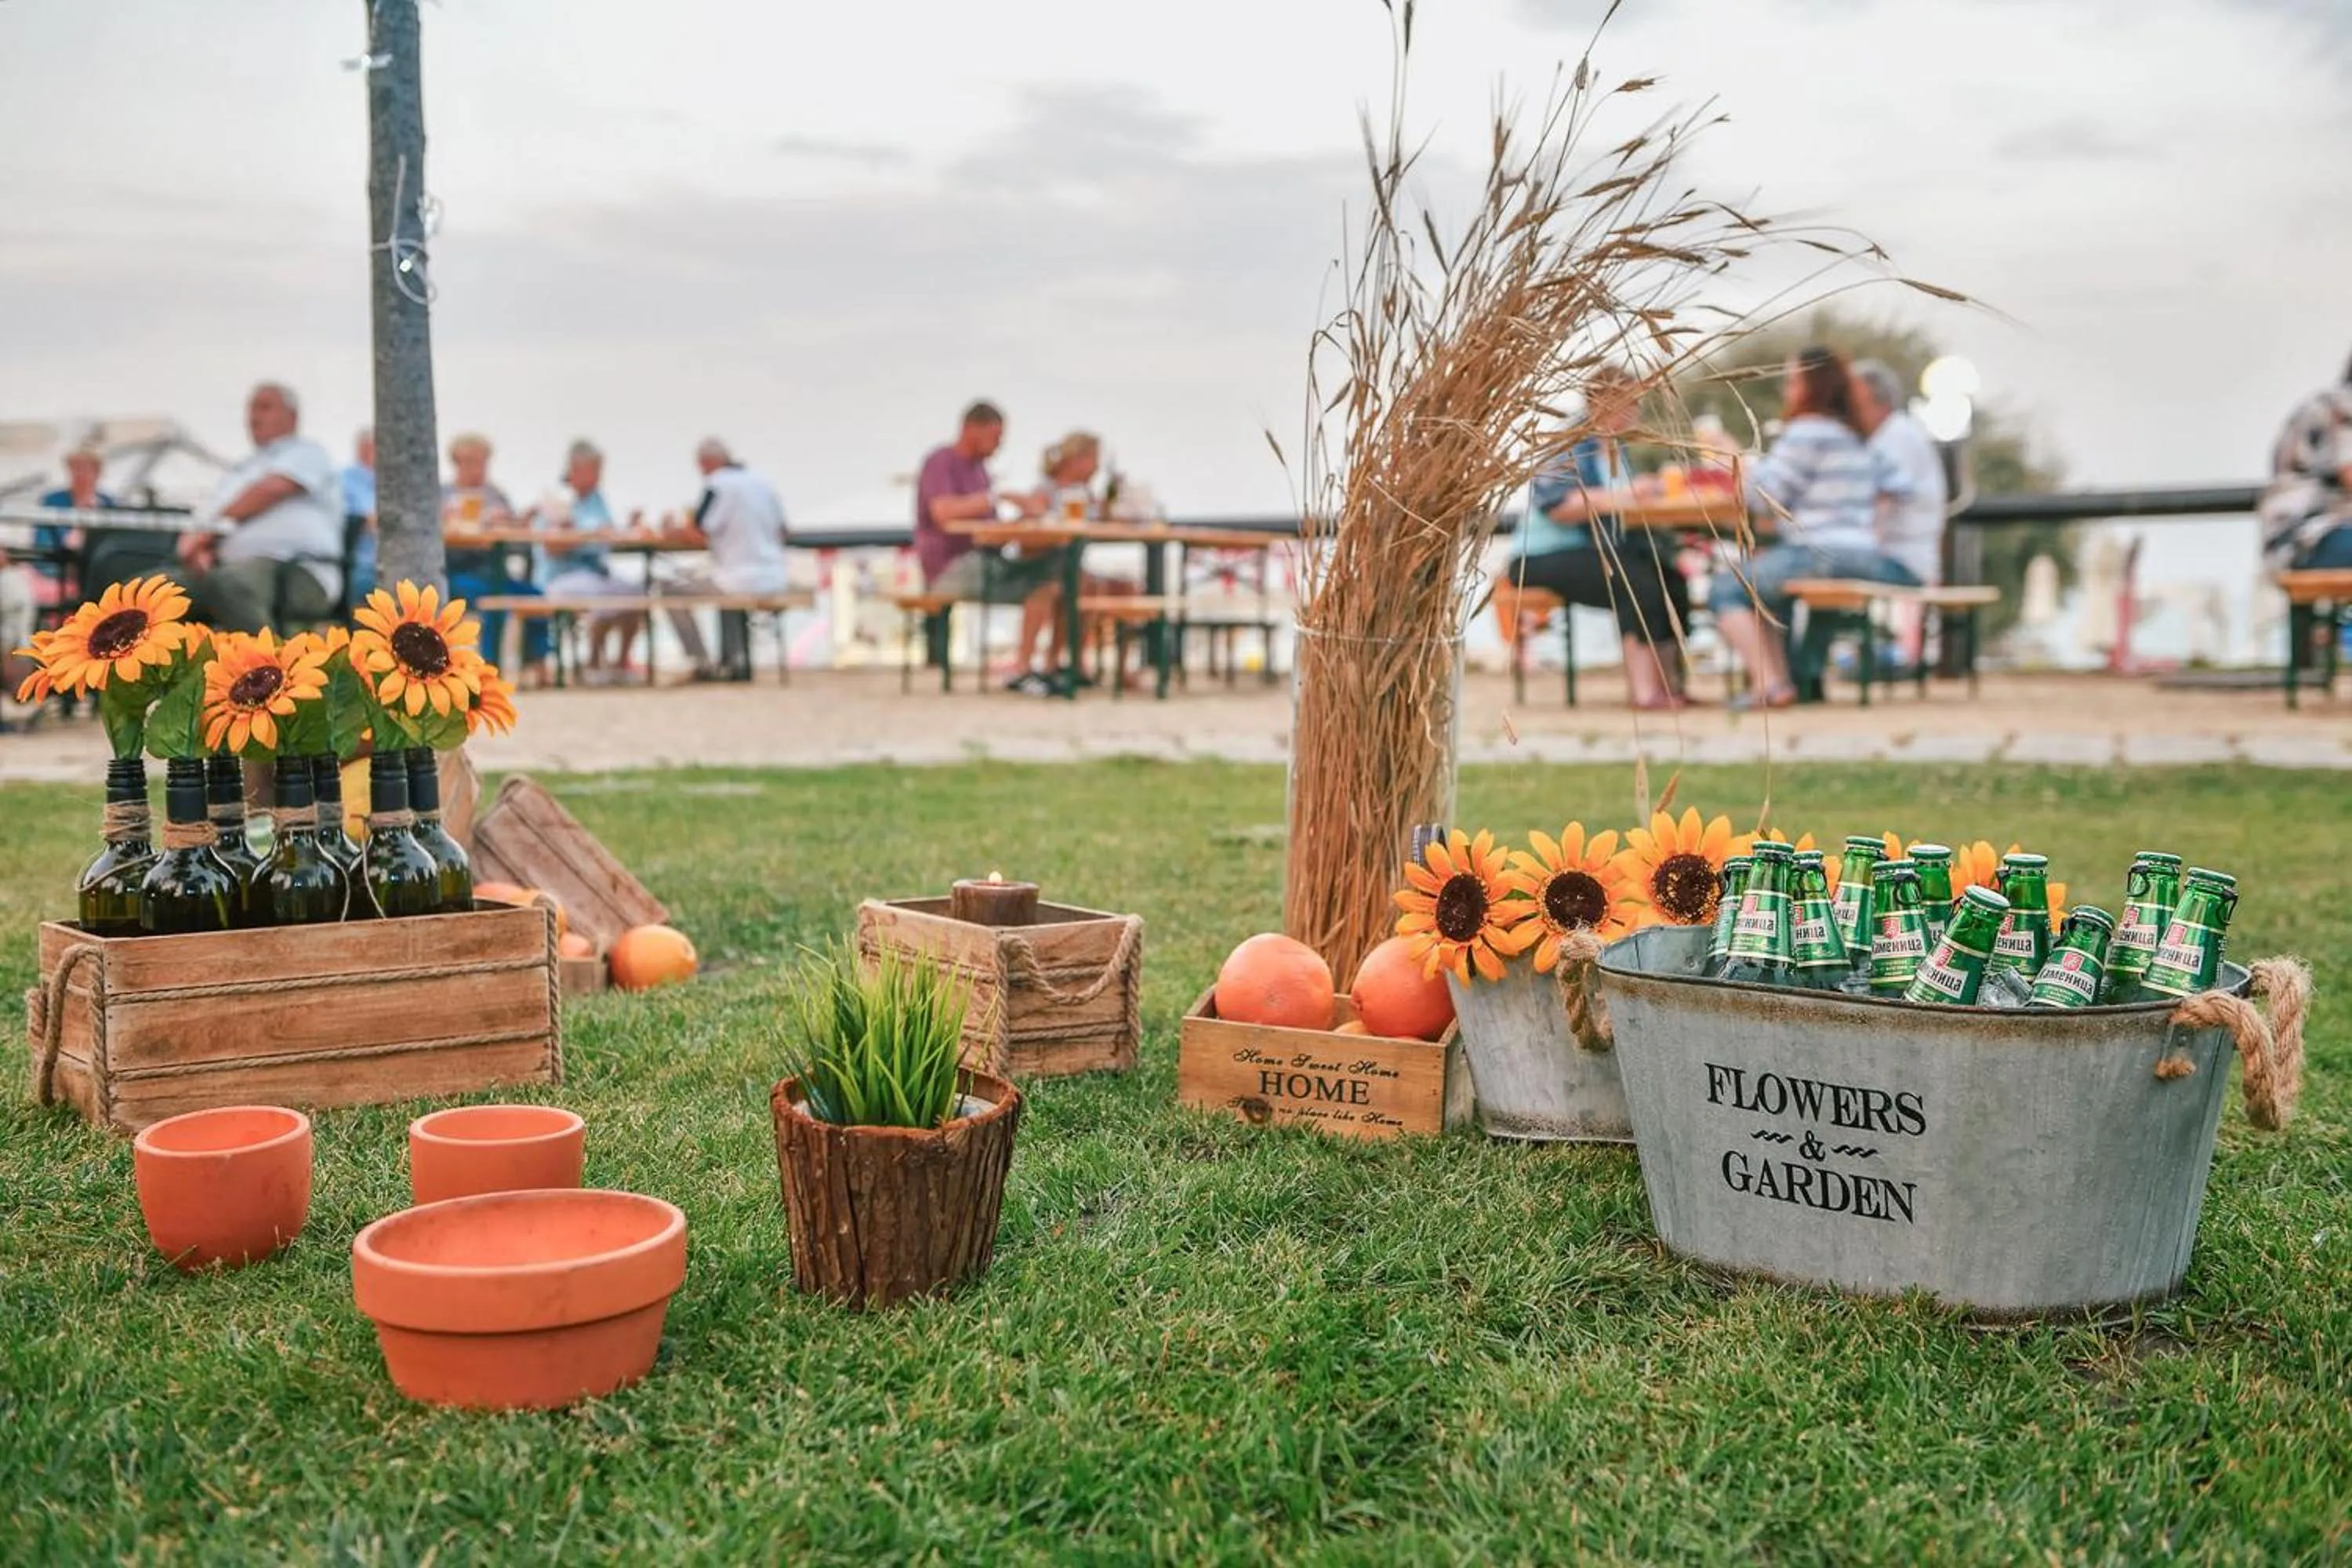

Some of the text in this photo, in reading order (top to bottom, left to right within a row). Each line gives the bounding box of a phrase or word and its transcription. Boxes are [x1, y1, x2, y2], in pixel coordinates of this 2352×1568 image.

[1233, 1048, 1399, 1077] Home Sweet Home
[1258, 1070, 1370, 1105] HOME
[1704, 1062, 1926, 1136] FLOWERS
[1333, 1109, 1355, 1121] like
[1361, 1111, 1403, 1126] Home
[1798, 1130, 1826, 1162] &
[1722, 1150, 1918, 1224] GARDEN
